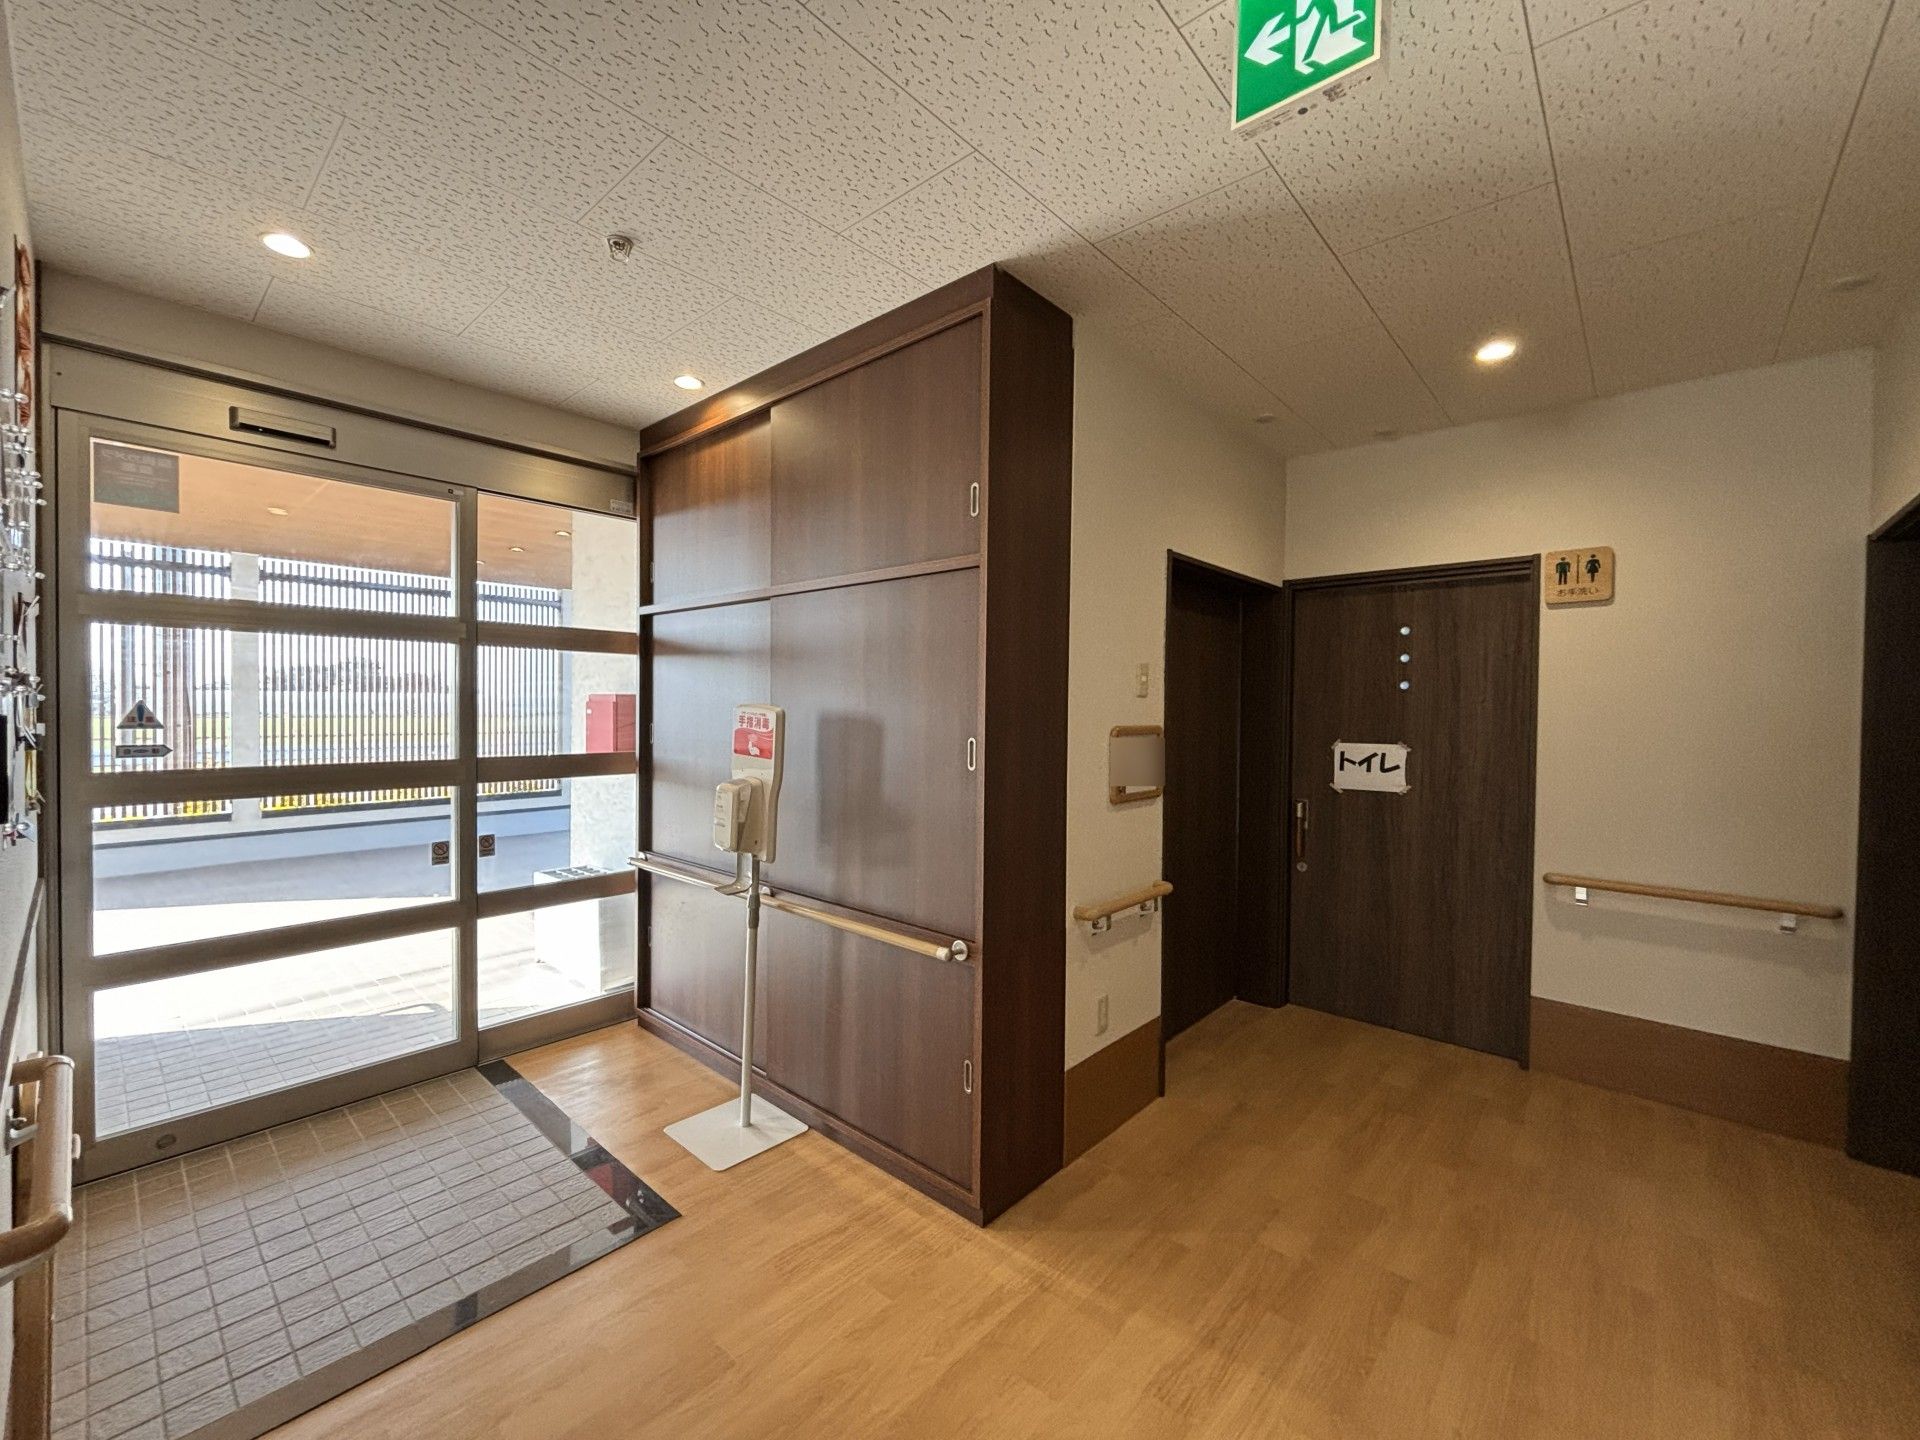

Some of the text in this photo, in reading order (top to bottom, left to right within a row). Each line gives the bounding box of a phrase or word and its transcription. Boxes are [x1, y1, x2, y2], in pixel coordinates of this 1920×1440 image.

[738, 715, 770, 730] 手指消毒
[1340, 751, 1400, 773] トイレ
